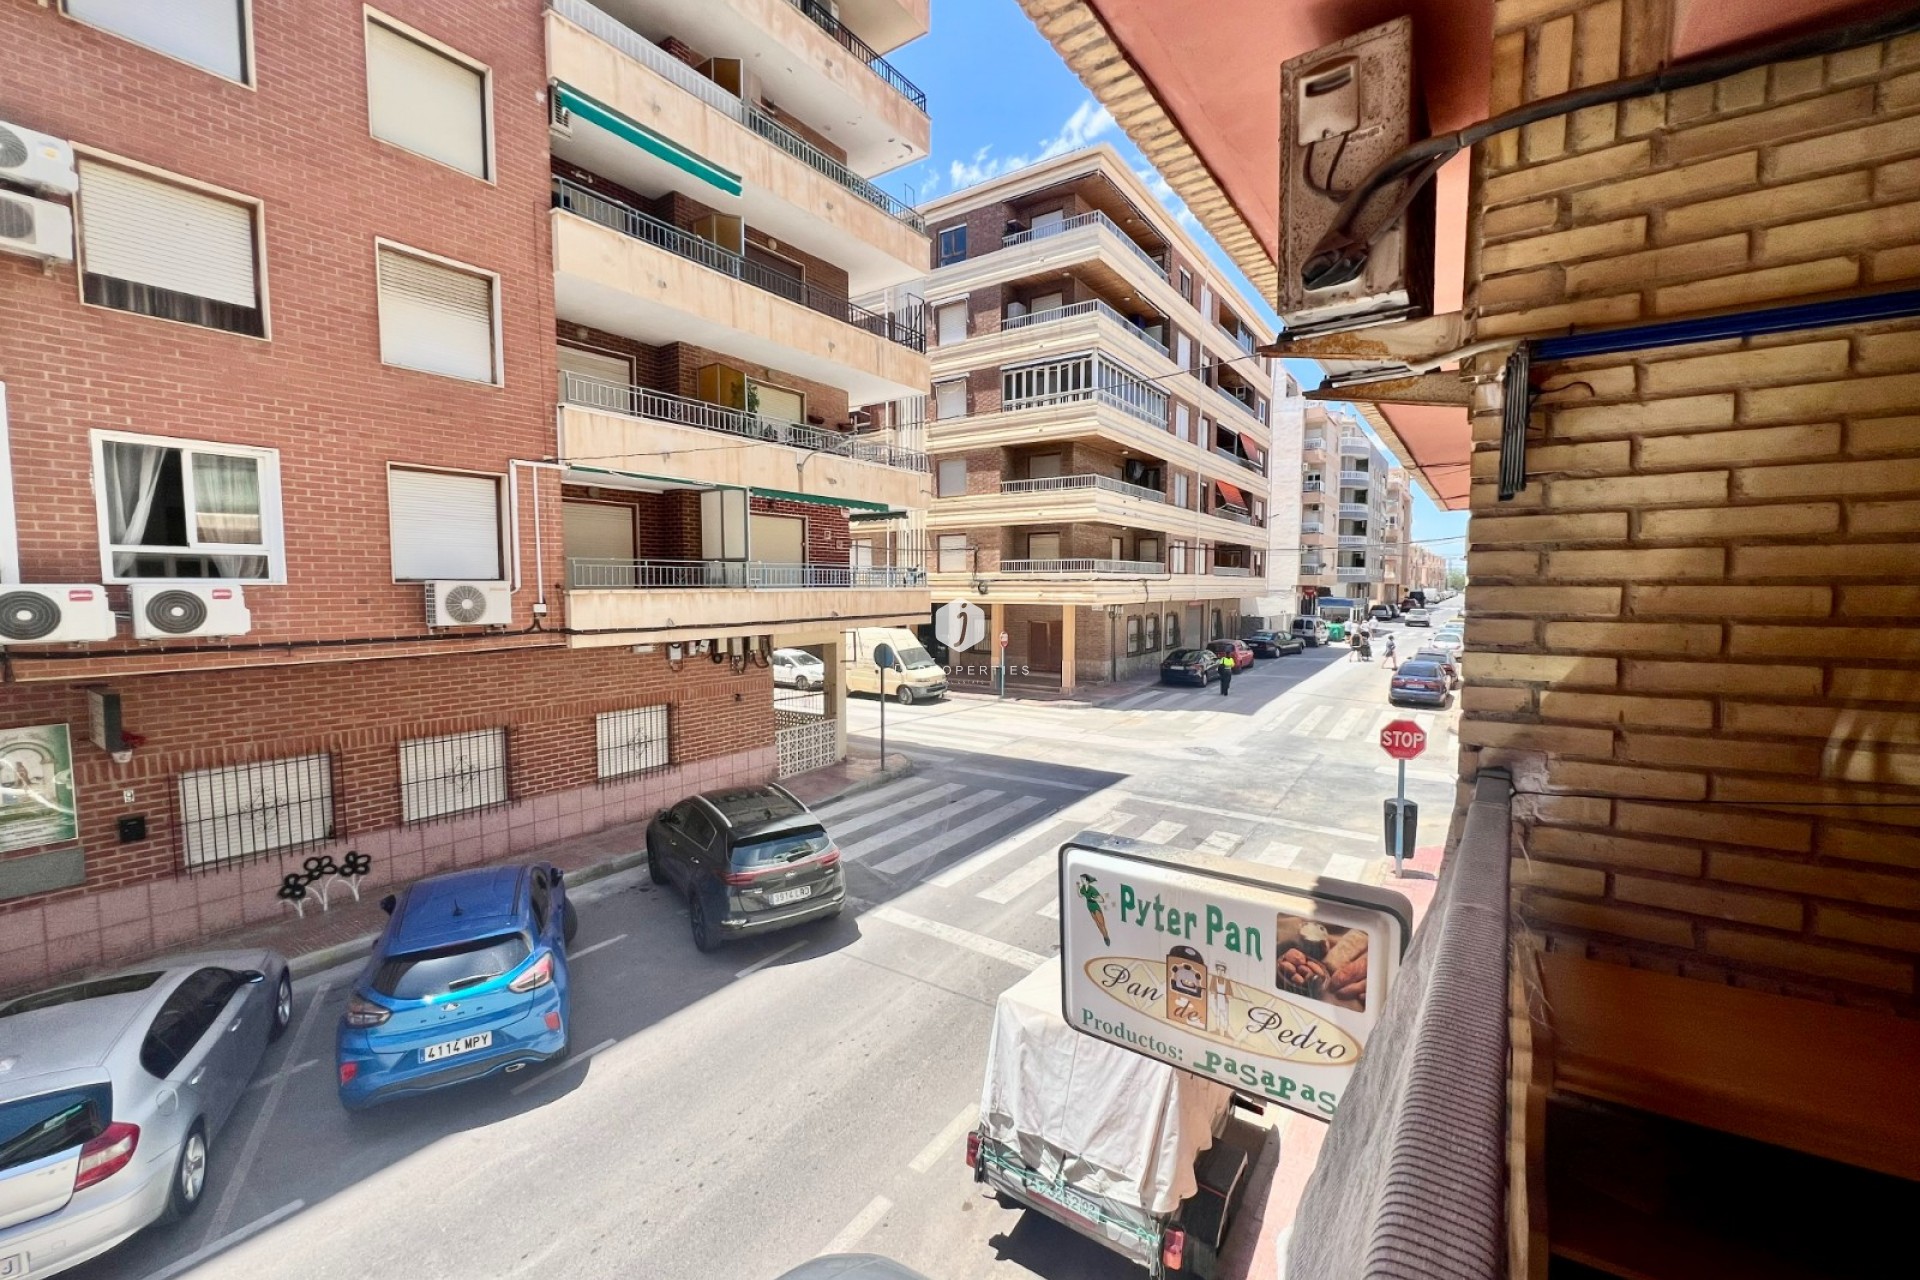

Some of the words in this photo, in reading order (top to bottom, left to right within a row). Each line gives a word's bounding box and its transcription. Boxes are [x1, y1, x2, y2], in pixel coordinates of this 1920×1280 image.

[1382, 730, 1424, 749] STOP
[1120, 883, 1197, 940] Pyter
[1206, 904, 1263, 962] Pan
[1102, 963, 1163, 1001] Pan
[1173, 997, 1201, 1020] de
[428, 1039, 460, 1058] 4114
[464, 1033, 488, 1049] MPY
[1081, 1008, 1183, 1061] Productos:
[1246, 1006, 1346, 1060] Pedro
